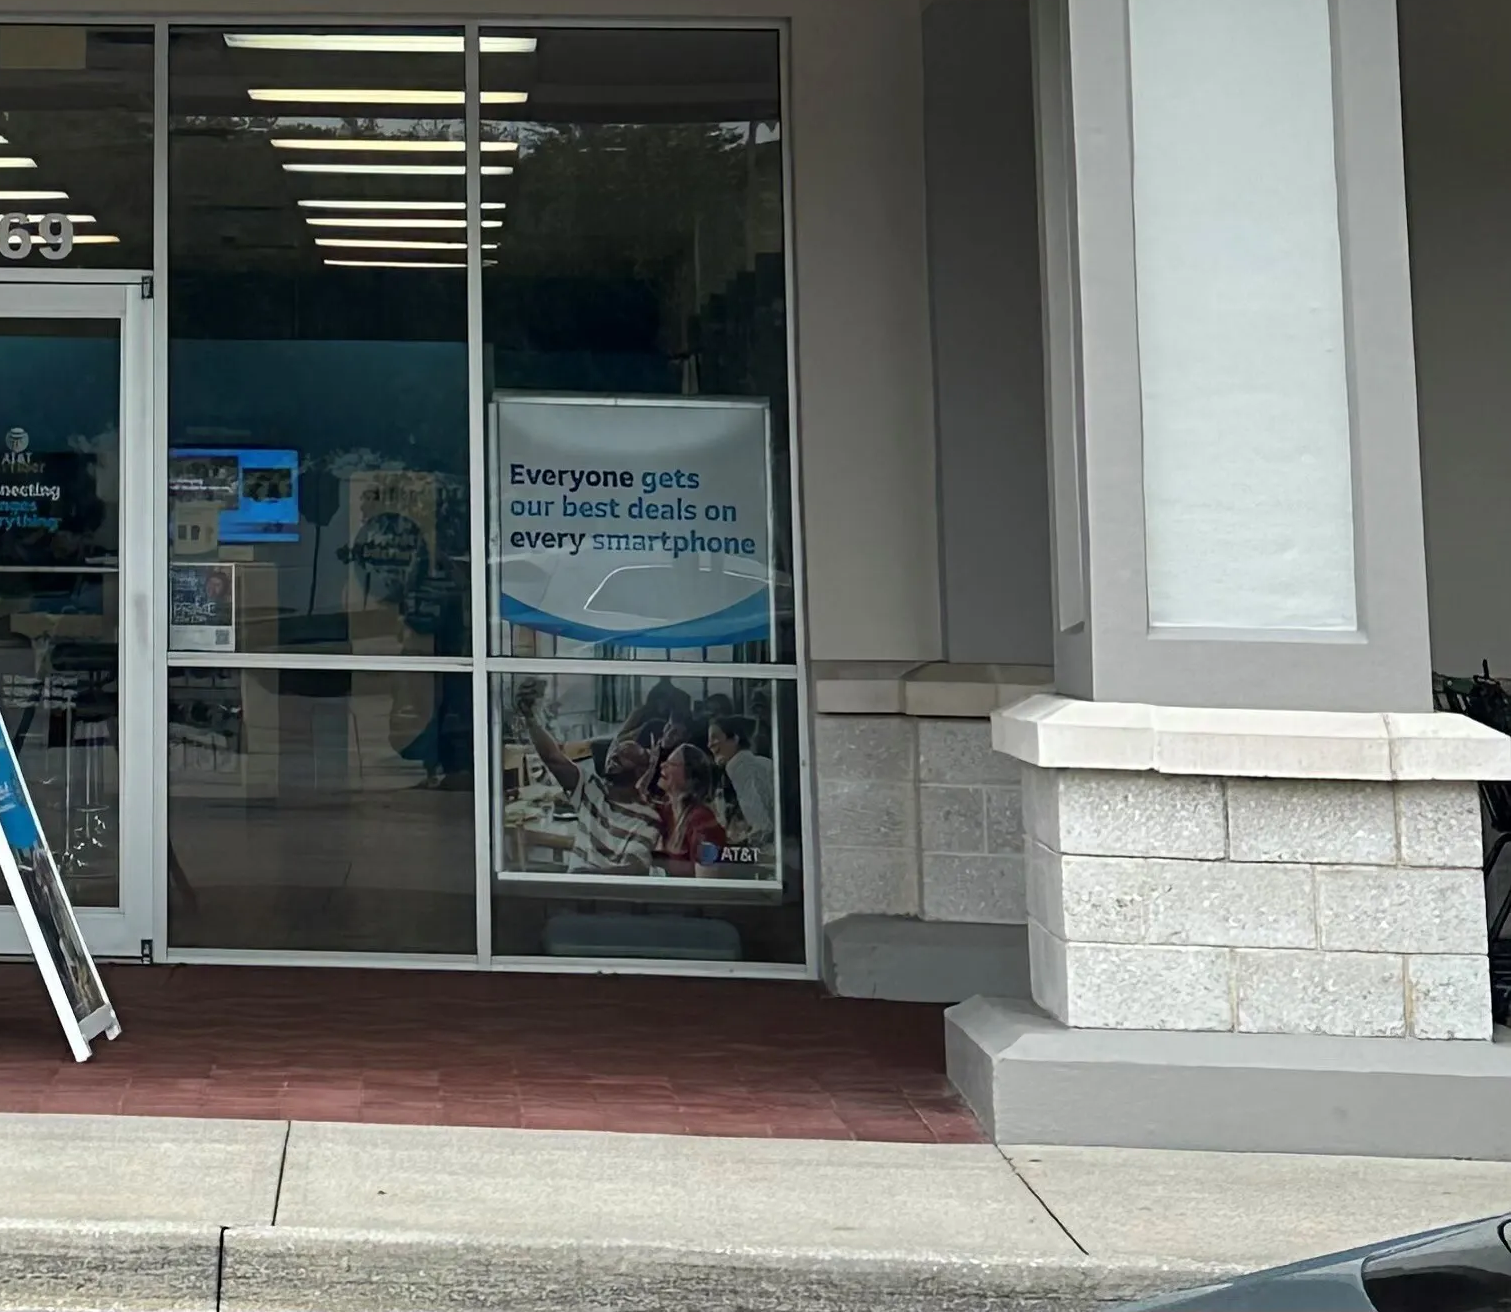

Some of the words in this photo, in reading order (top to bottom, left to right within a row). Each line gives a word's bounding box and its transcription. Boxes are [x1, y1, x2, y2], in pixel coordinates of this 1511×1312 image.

[509, 463, 634, 492] Everyone
[641, 469, 700, 494] gets
[509, 498, 555, 517] our
[562, 495, 621, 519] best
[627, 497, 697, 521] deals
[704, 504, 737, 522] on
[509, 530, 587, 555] every
[592, 530, 756, 559] smartphone
[720, 846, 760, 863] AT&T
